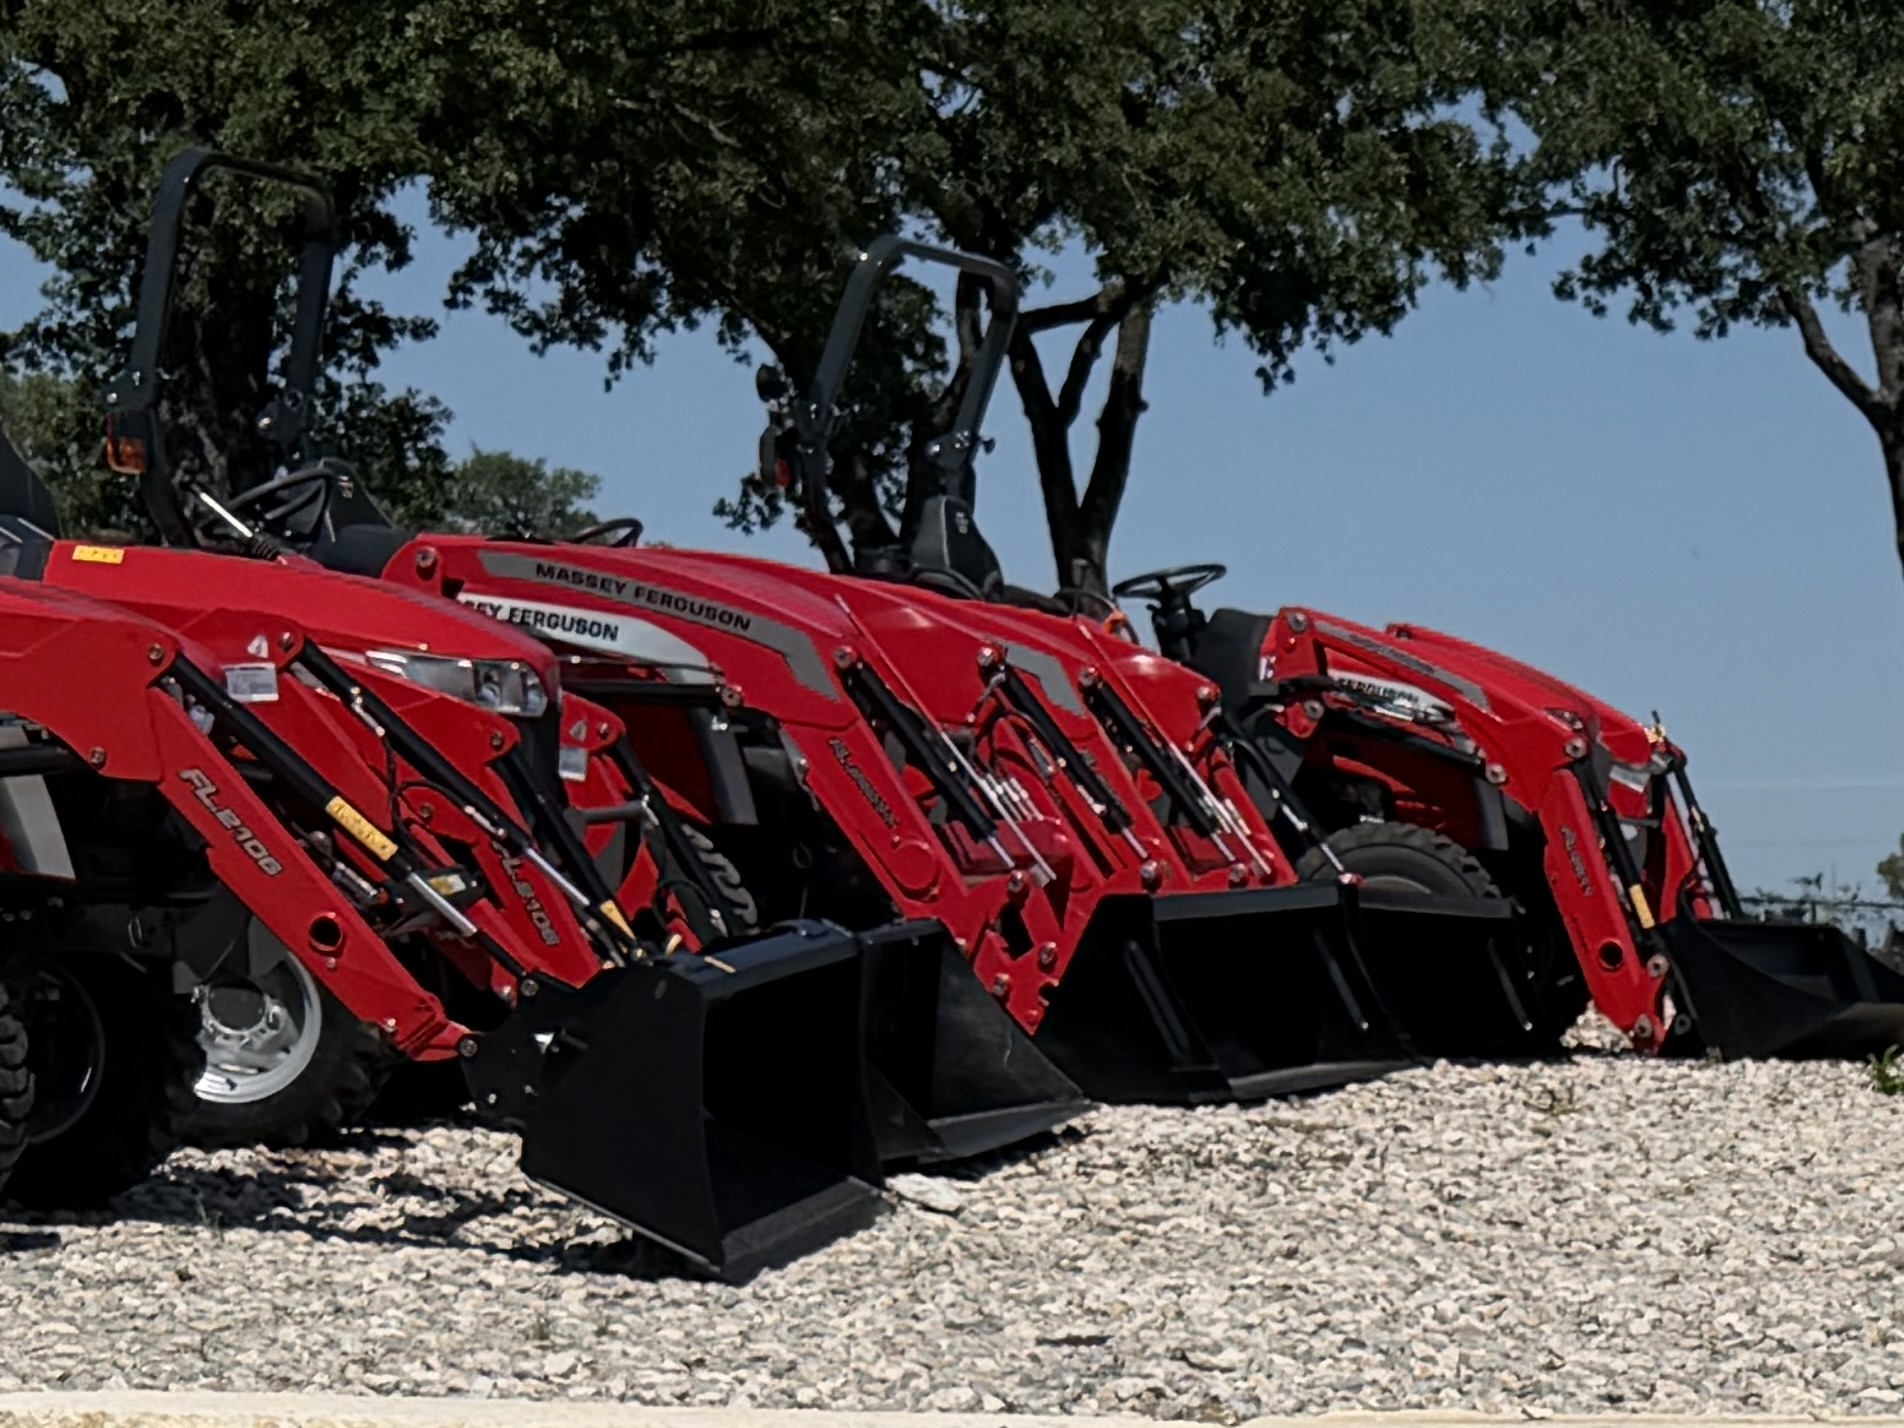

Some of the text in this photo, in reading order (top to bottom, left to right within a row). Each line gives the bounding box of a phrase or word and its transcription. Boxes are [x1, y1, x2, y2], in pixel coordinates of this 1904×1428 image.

[536, 562, 751, 632] MASSEY FERGUSON
[508, 607, 620, 642] FERGUSON
